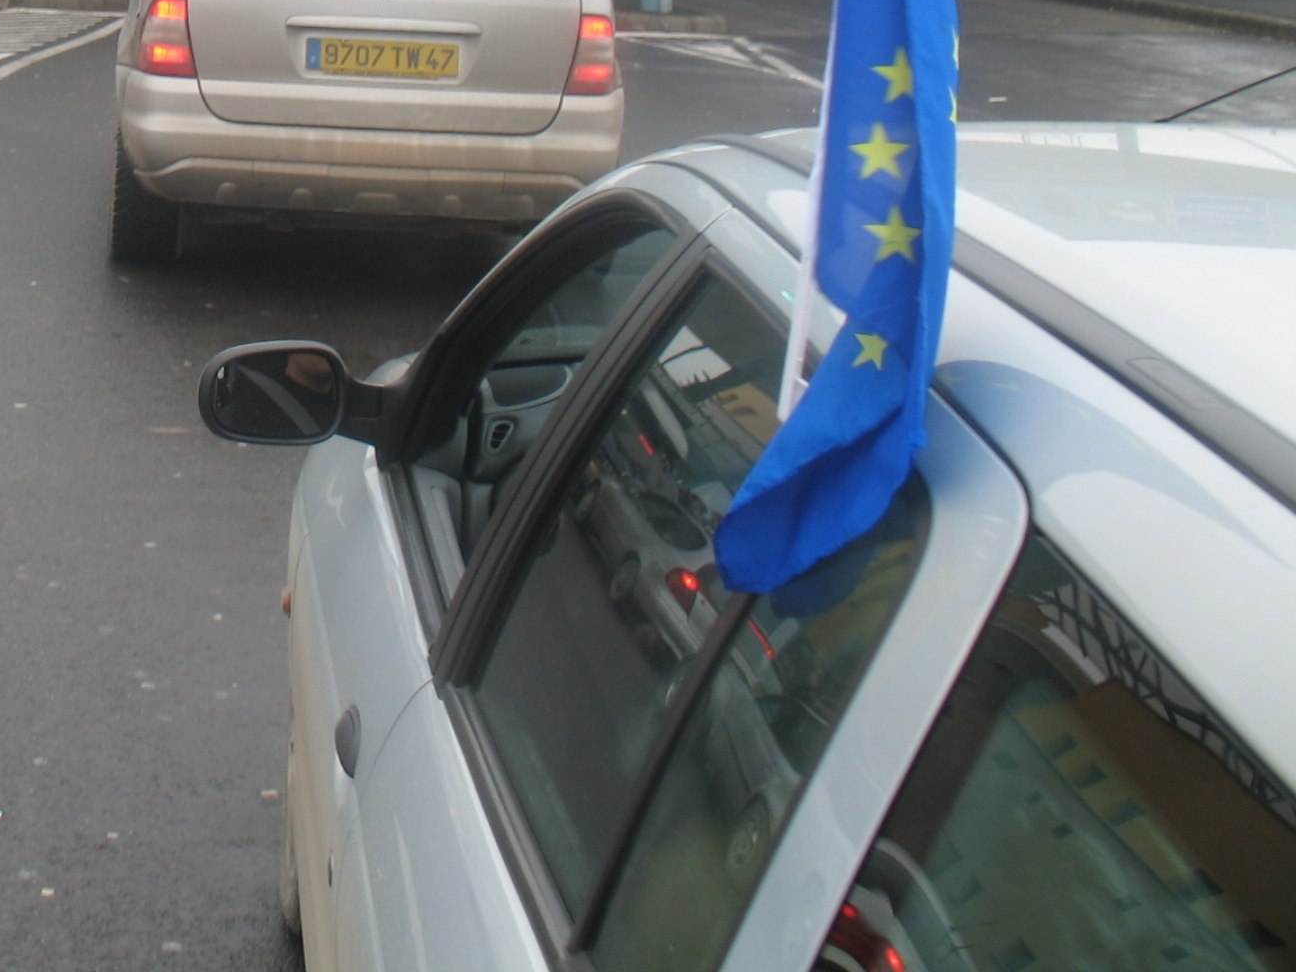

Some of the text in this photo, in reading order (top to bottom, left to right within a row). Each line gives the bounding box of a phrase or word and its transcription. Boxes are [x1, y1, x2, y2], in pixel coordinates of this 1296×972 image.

[324, 43, 455, 71] 9707 TW 47
